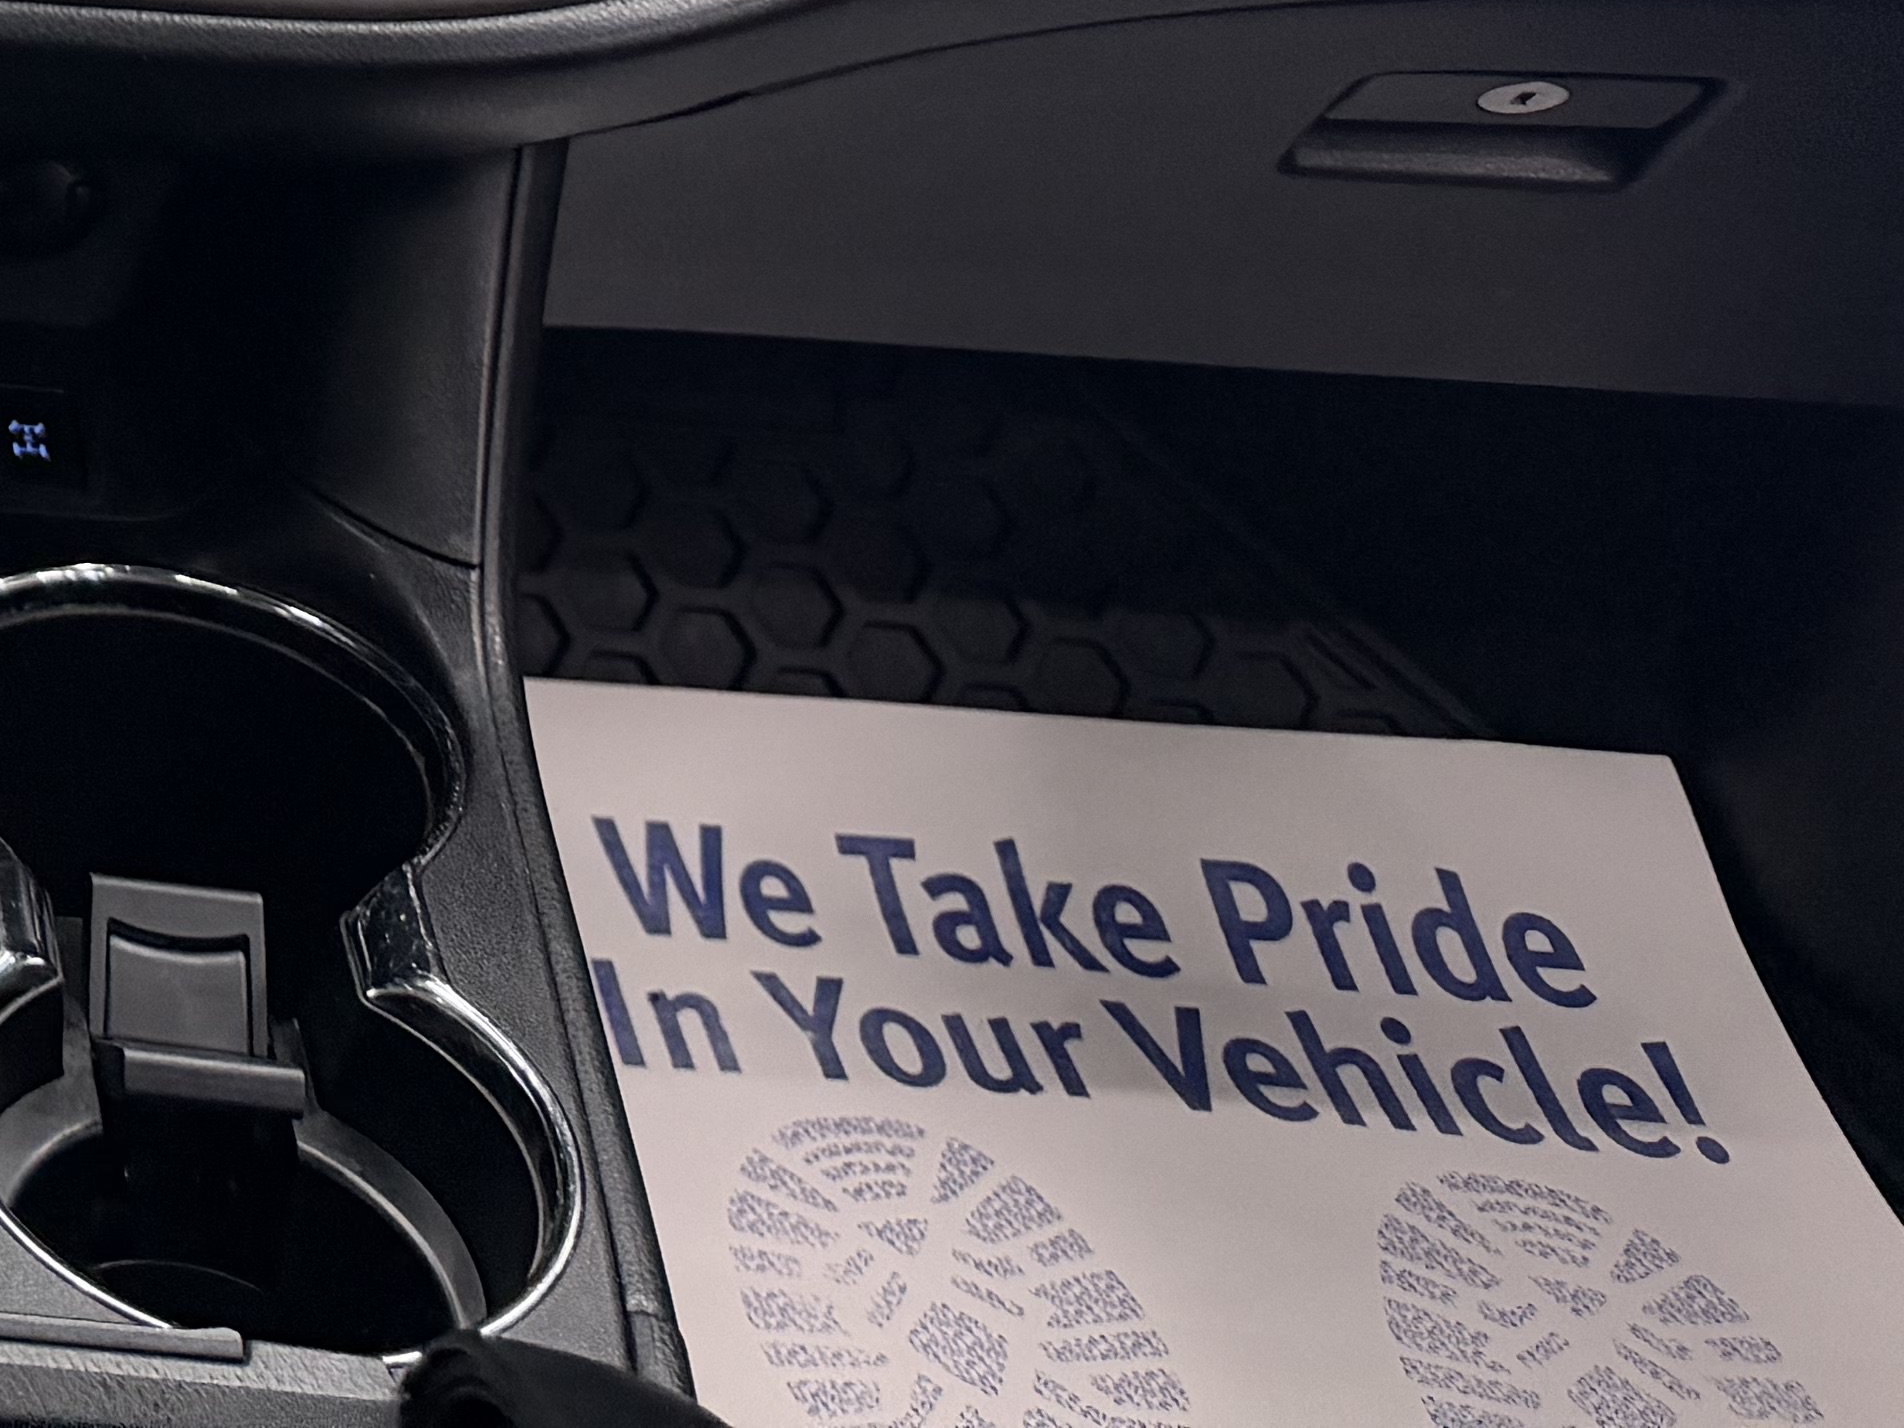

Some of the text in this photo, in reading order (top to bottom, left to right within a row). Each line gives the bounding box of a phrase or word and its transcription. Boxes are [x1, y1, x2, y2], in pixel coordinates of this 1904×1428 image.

[592, 816, 1600, 1011] We Take Pride
[592, 957, 1733, 1167] In Your Vehicle!
